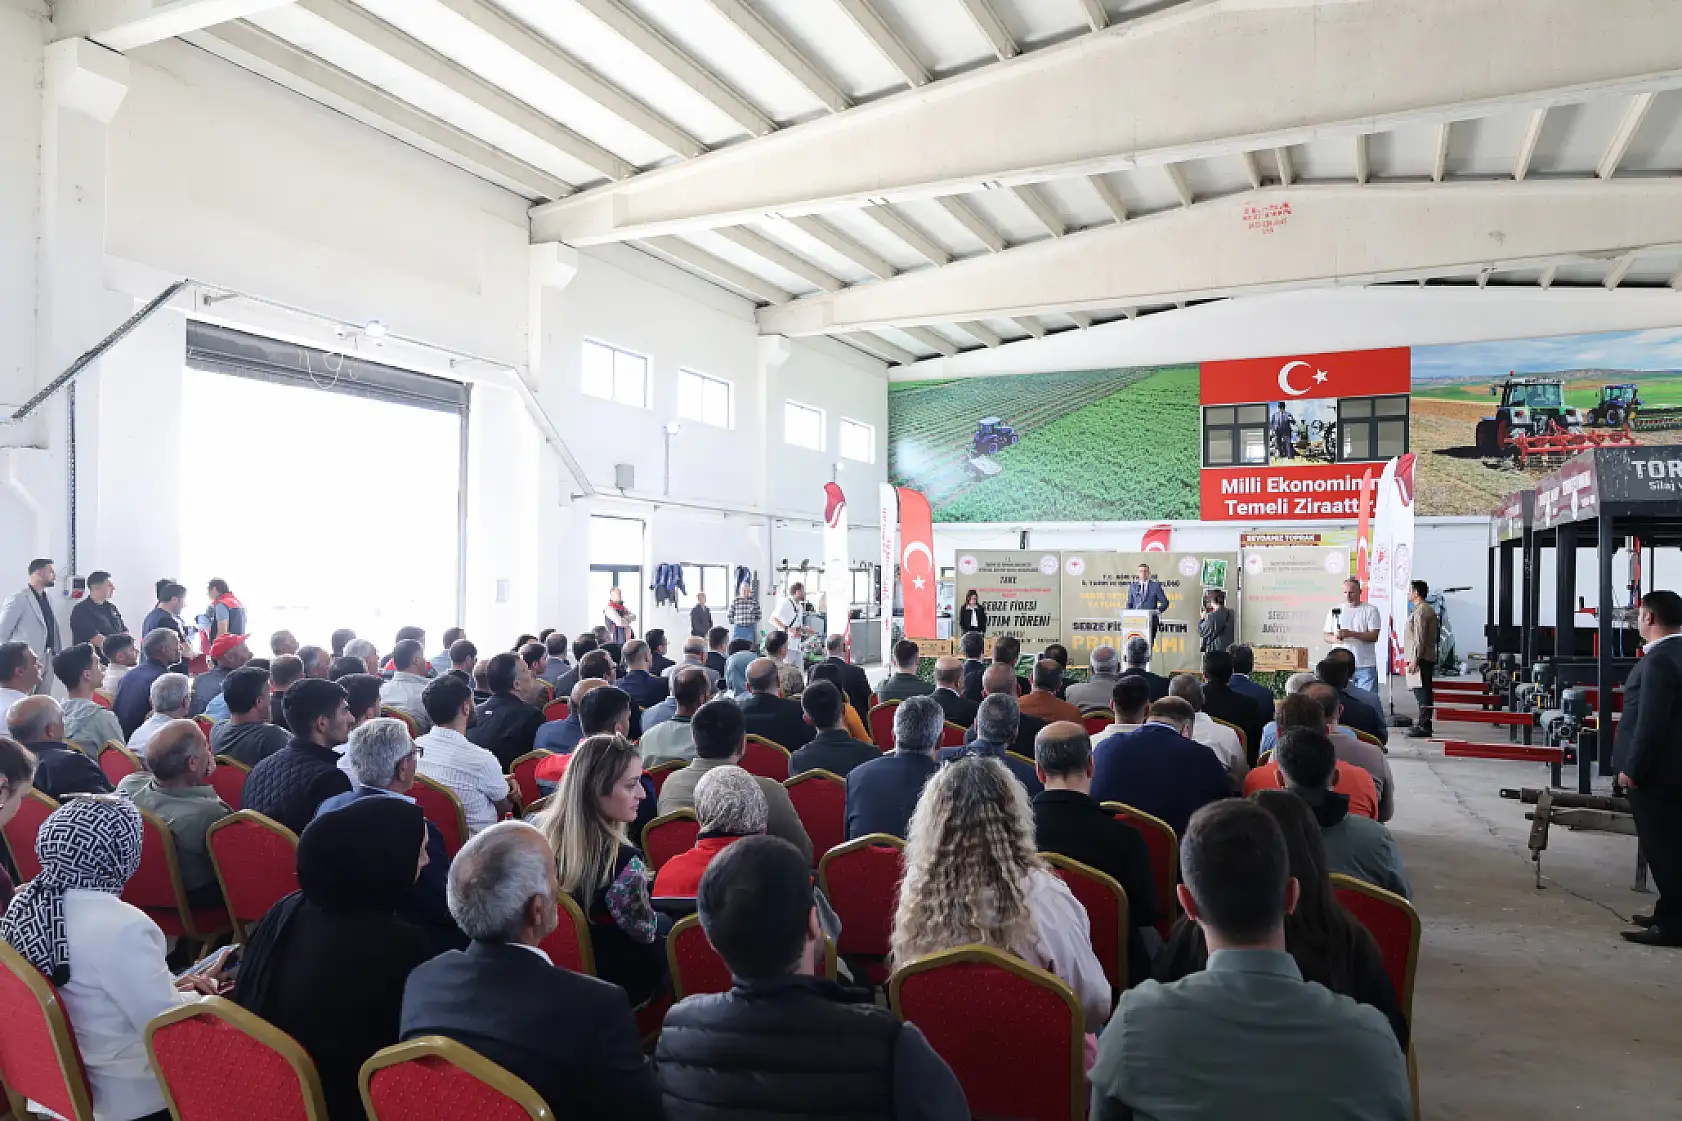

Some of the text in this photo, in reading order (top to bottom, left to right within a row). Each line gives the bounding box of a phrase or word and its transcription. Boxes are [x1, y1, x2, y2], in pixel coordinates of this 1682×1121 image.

[1221, 476, 1261, 494] Milli
[1649, 480, 1675, 491] Silaj
[1224, 498, 1288, 515] Temeli
[1014, 612, 1051, 627] TÖRENİ
[1072, 622, 1106, 632] SEBZE
